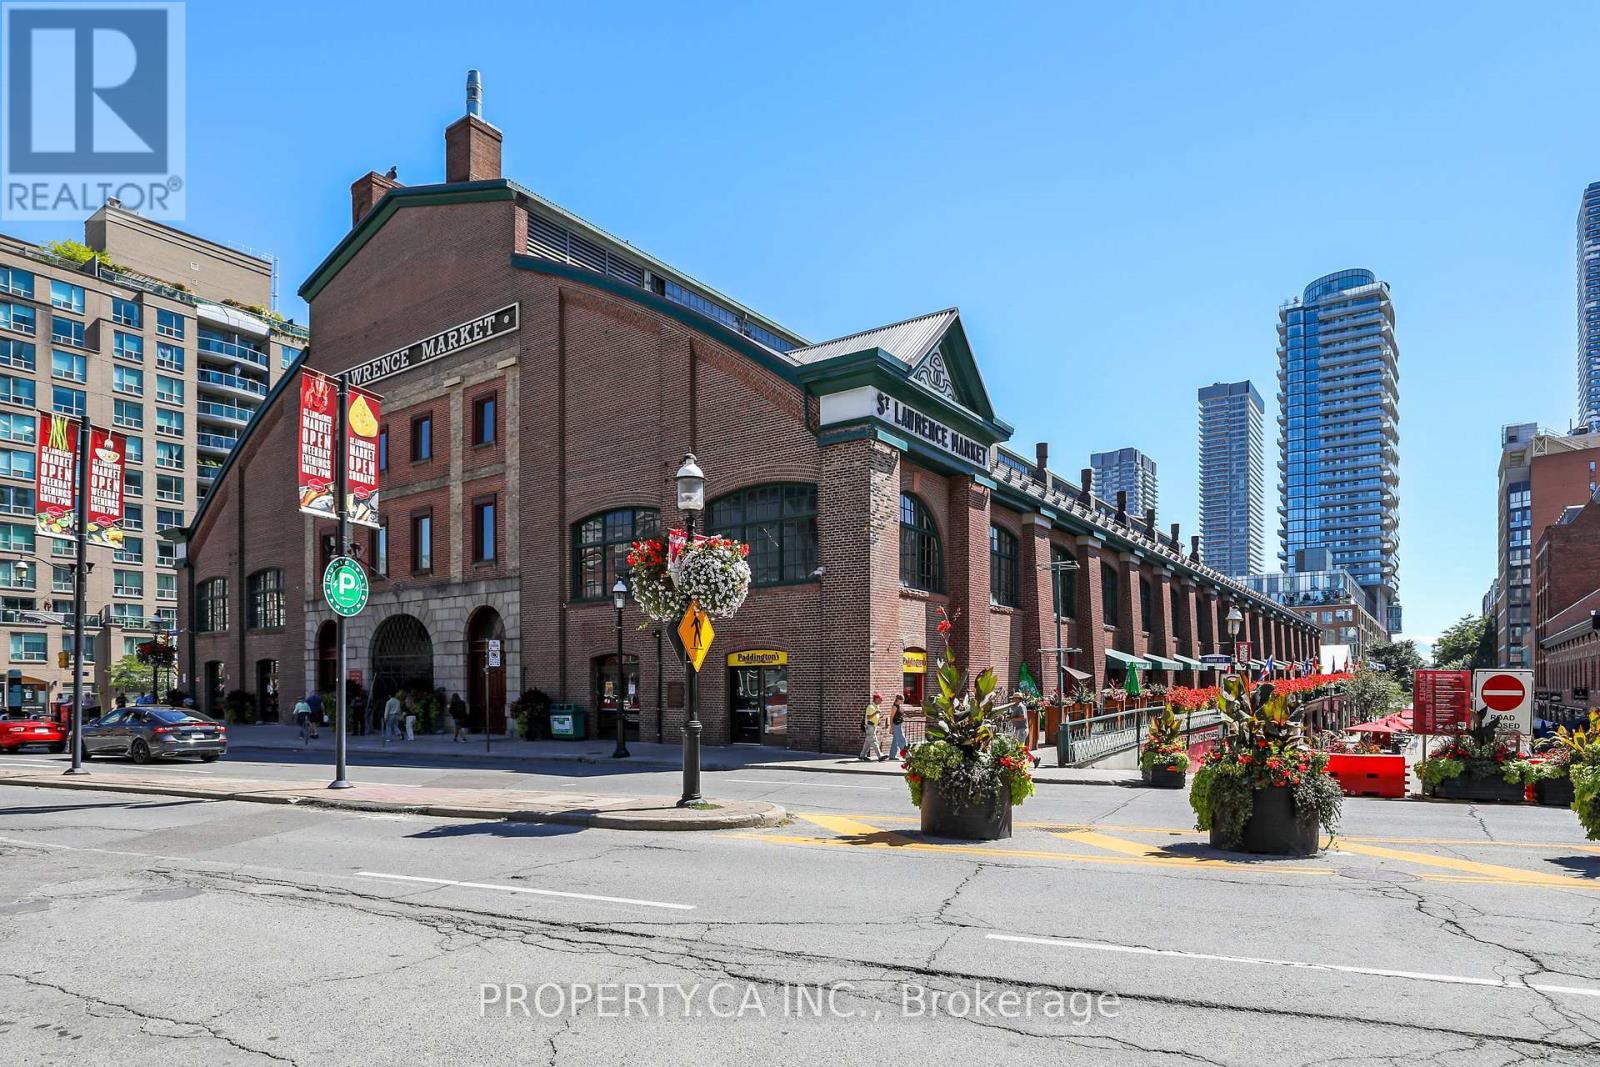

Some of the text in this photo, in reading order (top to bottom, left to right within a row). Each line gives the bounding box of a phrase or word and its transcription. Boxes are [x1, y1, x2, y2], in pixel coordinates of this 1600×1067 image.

[351, 315, 495, 385] WRENCE MARKET
[303, 416, 332, 435] MARKET
[894, 401, 948, 449] LAWRENCE
[951, 431, 986, 466] MARKET
[302, 427, 331, 451] OPEN
[41, 452, 72, 469] MARKET
[302, 443, 331, 460] WEEKDAY
[350, 444, 375, 462] MARKET
[302, 453, 331, 470] EVENINGS
[349, 455, 375, 476] OPEN
[41, 462, 72, 482] OPEN
[92, 465, 120, 480] MARKET
[317, 468, 331, 479] 7PM
[349, 470, 375, 485] SUNDAYS
[40, 476, 72, 490] WEEKDAY
[40, 484, 72, 499] EVENINGS
[91, 474, 120, 493] OPEN
[91, 486, 120, 501] WEEKDAY
[91, 495, 119, 509] EVENINGS
[326, 560, 366, 587] MUNICIPAL
[339, 572, 356, 594] P
[326, 589, 366, 613] PARKING
